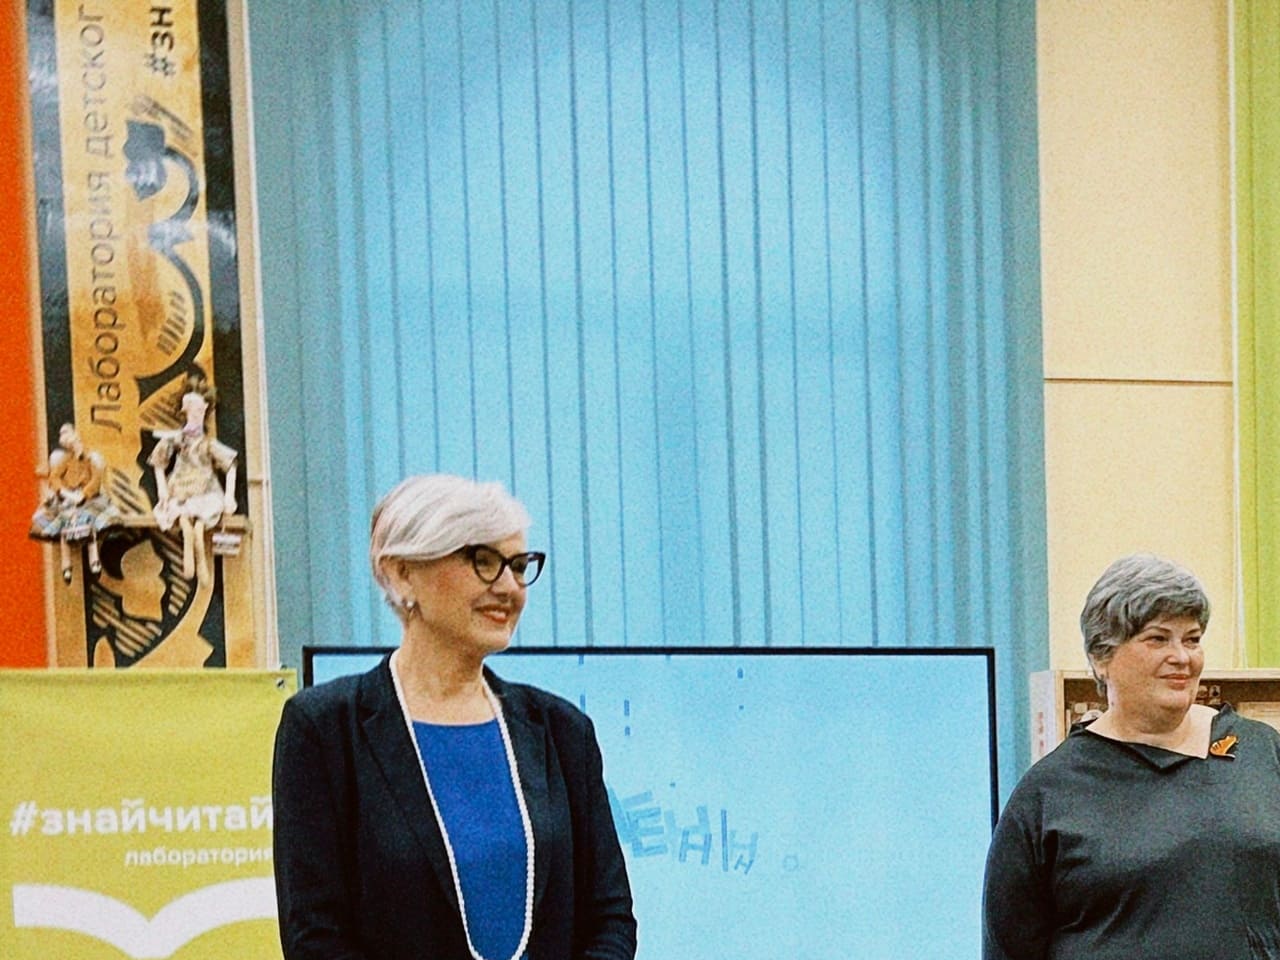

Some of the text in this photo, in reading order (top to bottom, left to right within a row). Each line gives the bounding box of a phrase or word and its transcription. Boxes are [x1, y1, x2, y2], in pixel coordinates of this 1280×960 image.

[88, 172, 126, 432] Лаборатория
[9, 796, 273, 836] #знайчитай
[124, 846, 273, 869] лаборатория
